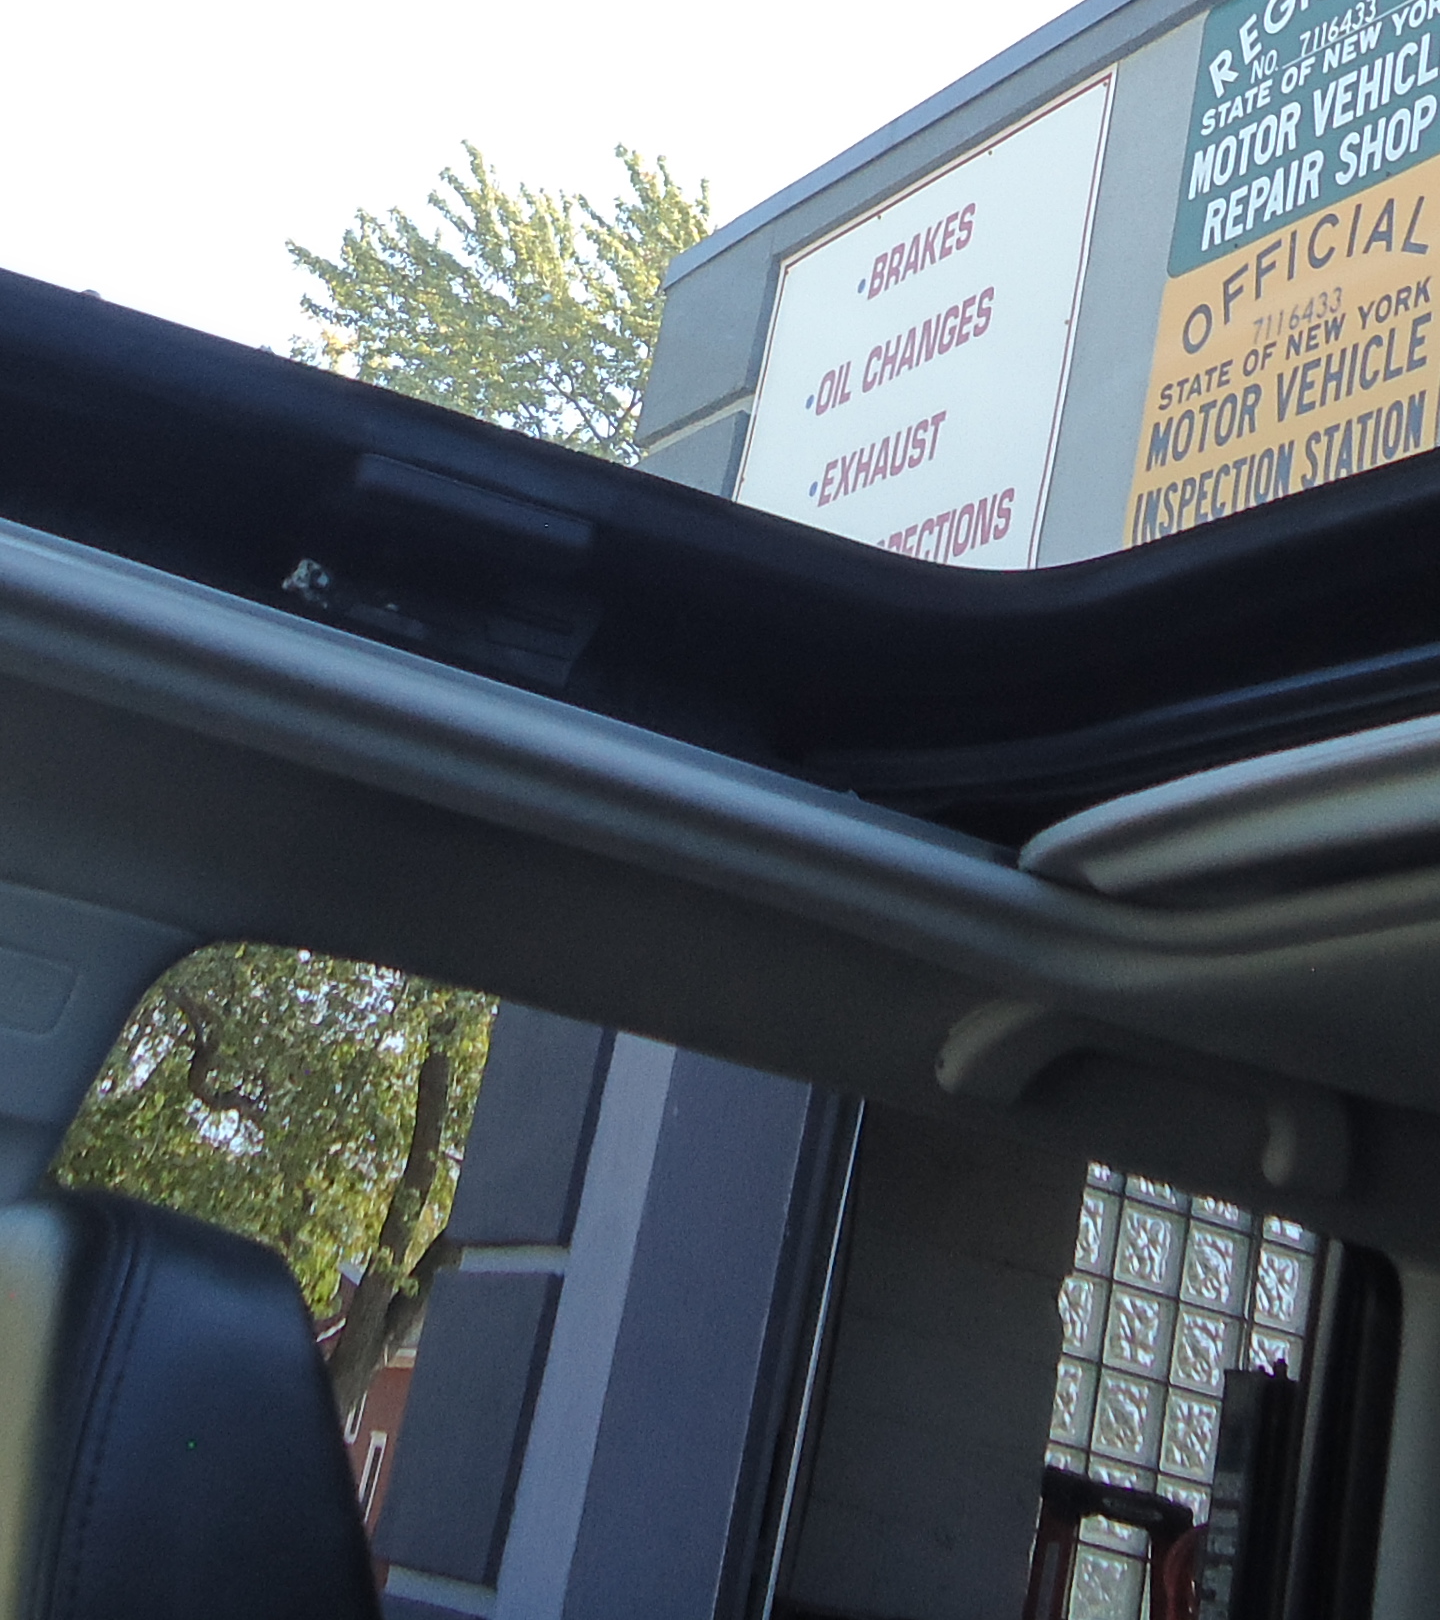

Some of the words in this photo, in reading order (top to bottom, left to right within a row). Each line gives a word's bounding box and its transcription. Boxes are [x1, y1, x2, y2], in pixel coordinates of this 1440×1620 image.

[1200, 79, 1273, 136] STATE
[1281, 57, 1316, 94] OF
[1322, 22, 1383, 73] NEW
[1251, 49, 1279, 84] NO.
[1188, 101, 1301, 200] MOTOR
[1201, 149, 1324, 251] REPAIR
[1335, 94, 1438, 186] SHOP
[867, 202, 976, 300] BRAKES
[1182, 195, 1430, 355] OFFICIAL
[815, 361, 852, 416] OIL
[862, 286, 995, 393] CHANGES
[1158, 359, 1234, 411] STATE
[1242, 341, 1277, 377] OF
[1285, 312, 1347, 361] NEW
[1357, 276, 1432, 330] YORK
[1252, 287, 1343, 345] 7116433
[1145, 383, 1263, 472] MOTOR
[1277, 312, 1433, 423] VEHICLE
[817, 410, 947, 508] EXHAUST
[1131, 439, 1296, 547] INSPECTION
[1299, 389, 1427, 489] STATION
